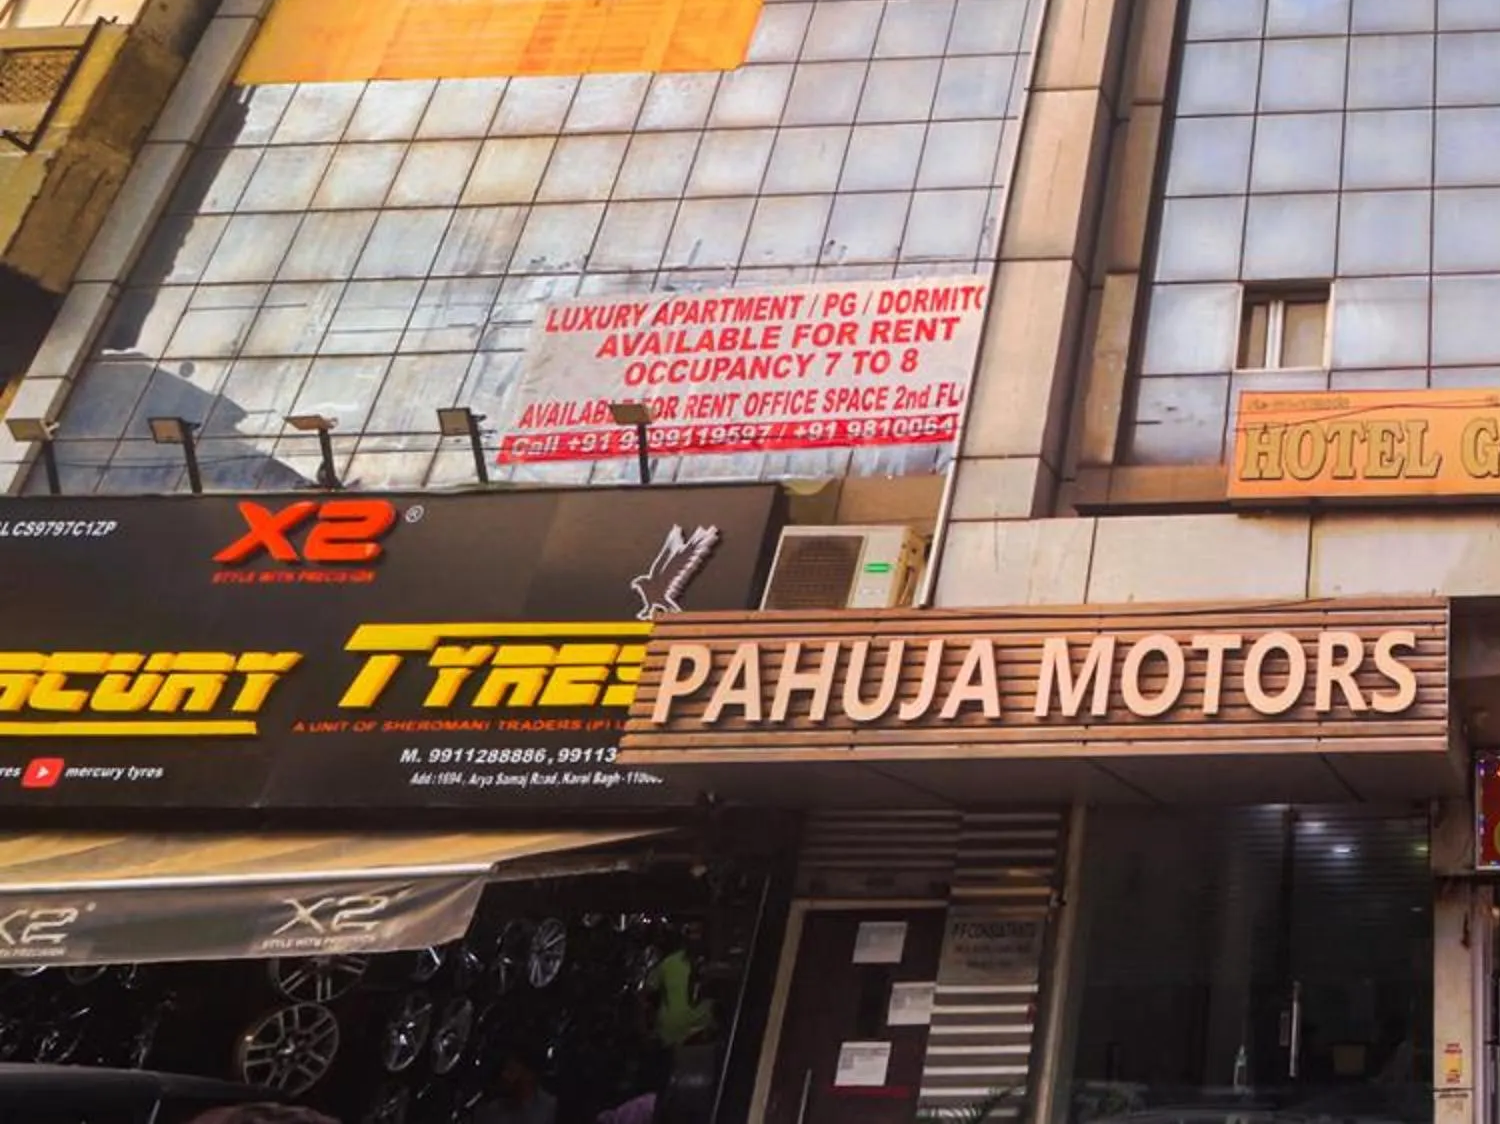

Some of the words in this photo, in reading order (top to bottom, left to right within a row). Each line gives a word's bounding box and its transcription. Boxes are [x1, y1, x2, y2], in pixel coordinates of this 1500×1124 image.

[545, 303, 649, 333] LUXURY
[651, 295, 804, 326] APARTMENT
[822, 291, 858, 318] PG
[596, 325, 783, 358] AVAILABLE
[791, 322, 860, 348] FOR
[869, 316, 961, 344] RENT
[623, 353, 815, 386] OCCUPANCY
[824, 352, 842, 376] 7
[852, 349, 892, 375] TO
[899, 347, 920, 373] 8
[683, 392, 741, 420] RENT
[743, 387, 819, 417] OFFICE
[822, 385, 889, 413] SPACE
[892, 383, 932, 410] 2nd
[935, 381, 965, 407] FL
[1240, 418, 1443, 480] HOTEL
[211, 500, 397, 562] X2
[649, 637, 1001, 727] PAHUJA
[1033, 629, 1420, 720] MOTORS
[292, 721, 306, 734] A
[308, 721, 349, 734] UNIT
[352, 721, 378, 733] OF
[382, 720, 490, 733] SHEROMANI
[498, 719, 583, 733] TRADERS
[64, 766, 125, 781] mercury
[127, 765, 164, 781] tyres
[400, 747, 422, 763] M.
[468, 772, 494, 788] Arya
[496, 772, 528, 789] Samaj
[272, 894, 392, 937] X2
